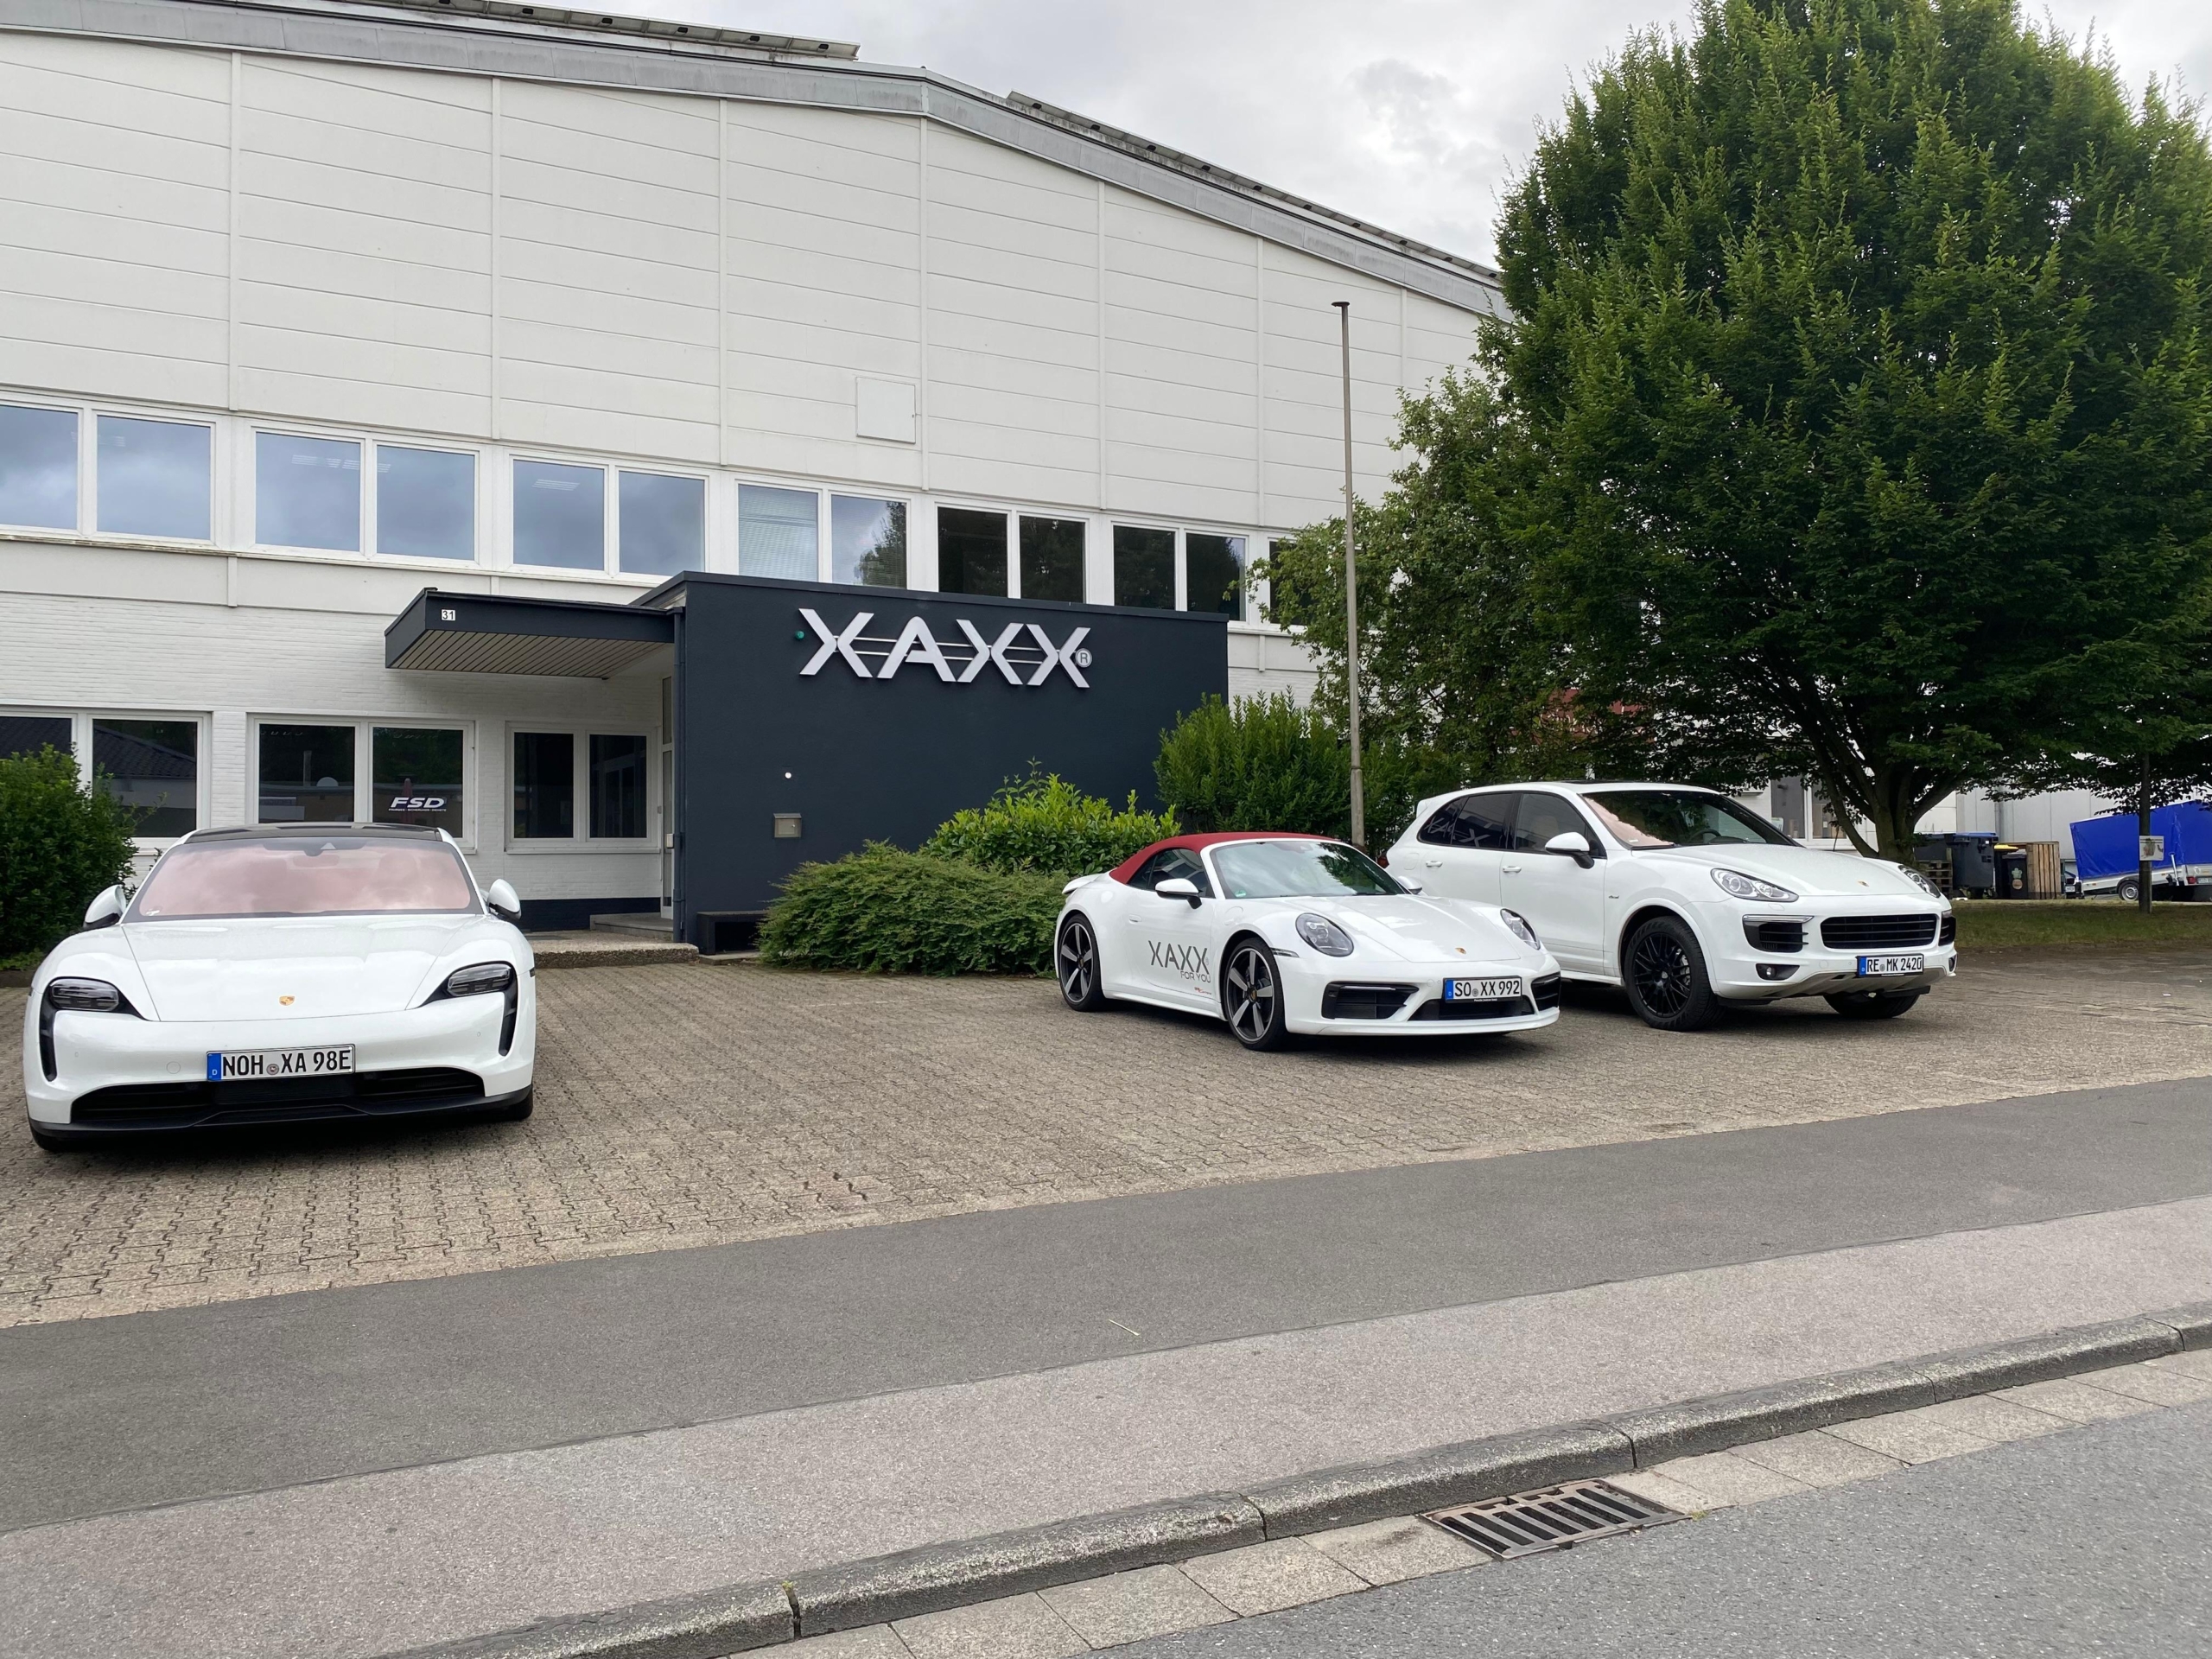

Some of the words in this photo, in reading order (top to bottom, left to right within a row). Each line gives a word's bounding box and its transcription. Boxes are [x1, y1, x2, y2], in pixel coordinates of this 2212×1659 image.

[442, 610, 454, 620] 31
[798, 607, 1091, 689] XAXX
[391, 797, 445, 808] FSD
[1147, 939, 1210, 975] XAXX
[1867, 958, 1879, 973] RE
[1886, 957, 1898, 972] MK
[1180, 970, 1195, 981] FOR
[1196, 973, 1211, 983] YOU
[1454, 982, 1471, 997] SO
[1480, 981, 1496, 996] XX
[1498, 980, 1520, 995] 992
[223, 1054, 264, 1077] NOH
[281, 1052, 307, 1073] XA
[313, 1049, 351, 1071] 98E
